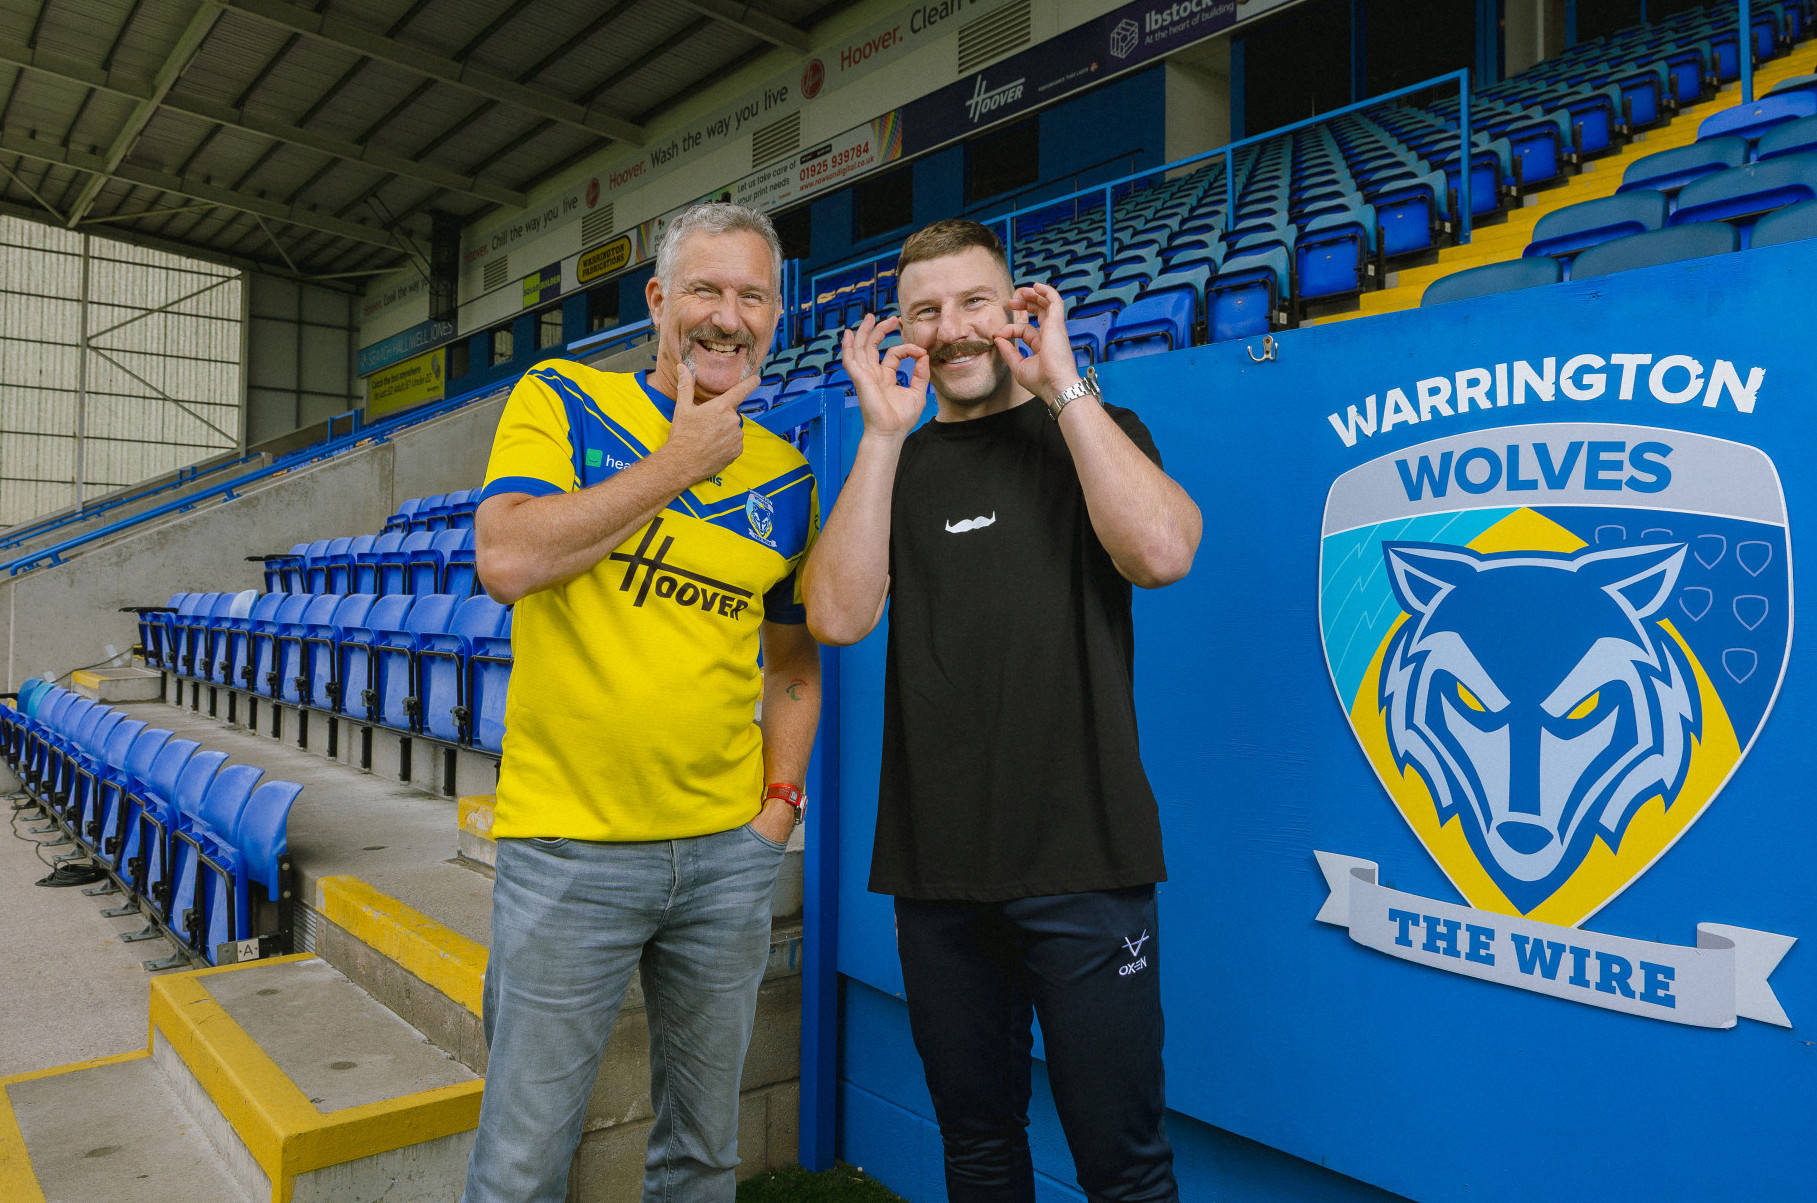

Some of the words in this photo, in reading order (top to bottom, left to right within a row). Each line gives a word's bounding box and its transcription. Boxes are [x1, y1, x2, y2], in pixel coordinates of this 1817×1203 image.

[841, 25, 903, 71] Hoover.
[911, 0, 961, 34] Clean
[1155, 30, 1168, 41] the
[1169, 20, 1190, 35] heart
[1191, 13, 1200, 26] of
[1202, 2, 1234, 21] building
[609, 160, 647, 191] Hoover.
[650, 139, 679, 168] Wash
[682, 131, 702, 152] the
[706, 114, 731, 137] way
[735, 101, 759, 130] you
[764, 86, 788, 111] live
[800, 159, 829, 182] 01925
[831, 140, 869, 168] 939784
[738, 182, 746, 193] Let
[748, 179, 756, 188] us
[757, 171, 771, 184] take
[773, 165, 788, 177] care
[789, 160, 796, 170] of
[754, 185, 768, 201] print
[770, 177, 790, 192] needs
[491, 230, 508, 250] Chill
[510, 225, 523, 242] the
[526, 216, 541, 233] way
[544, 207, 558, 229] you
[563, 196, 578, 216] live
[1327, 353, 1766, 447] WARRINGTON
[1395, 441, 1673, 501] WOLVES
[244, 943, 253, 956] A
[1119, 956, 1147, 976] OXEN
[1388, 908, 1495, 967] THE
[1511, 933, 1676, 1009] WIRE
